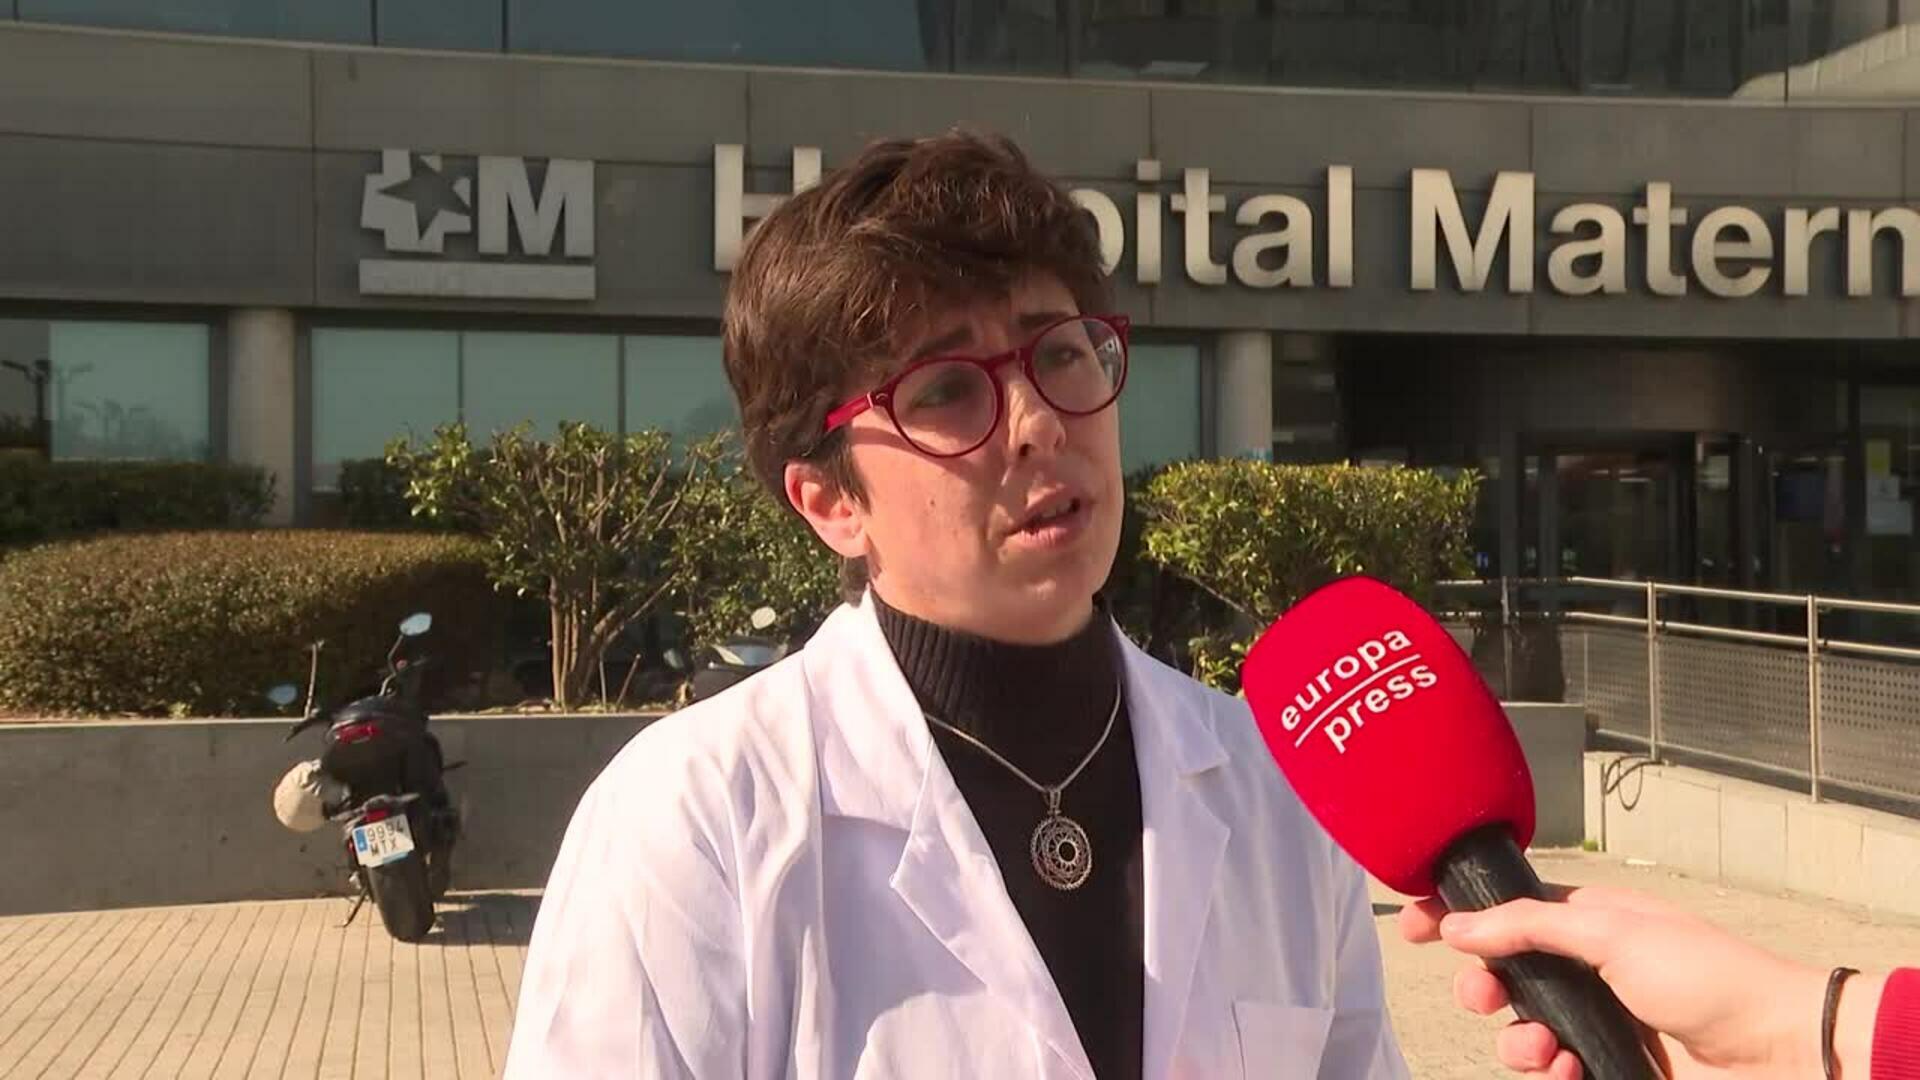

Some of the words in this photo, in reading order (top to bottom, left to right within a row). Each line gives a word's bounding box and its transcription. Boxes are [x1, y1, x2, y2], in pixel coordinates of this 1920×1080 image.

[714, 144, 1354, 287] Hital
[1411, 168, 1920, 297] Matern
[1281, 630, 1413, 731] europa
[1324, 665, 1438, 754] press
